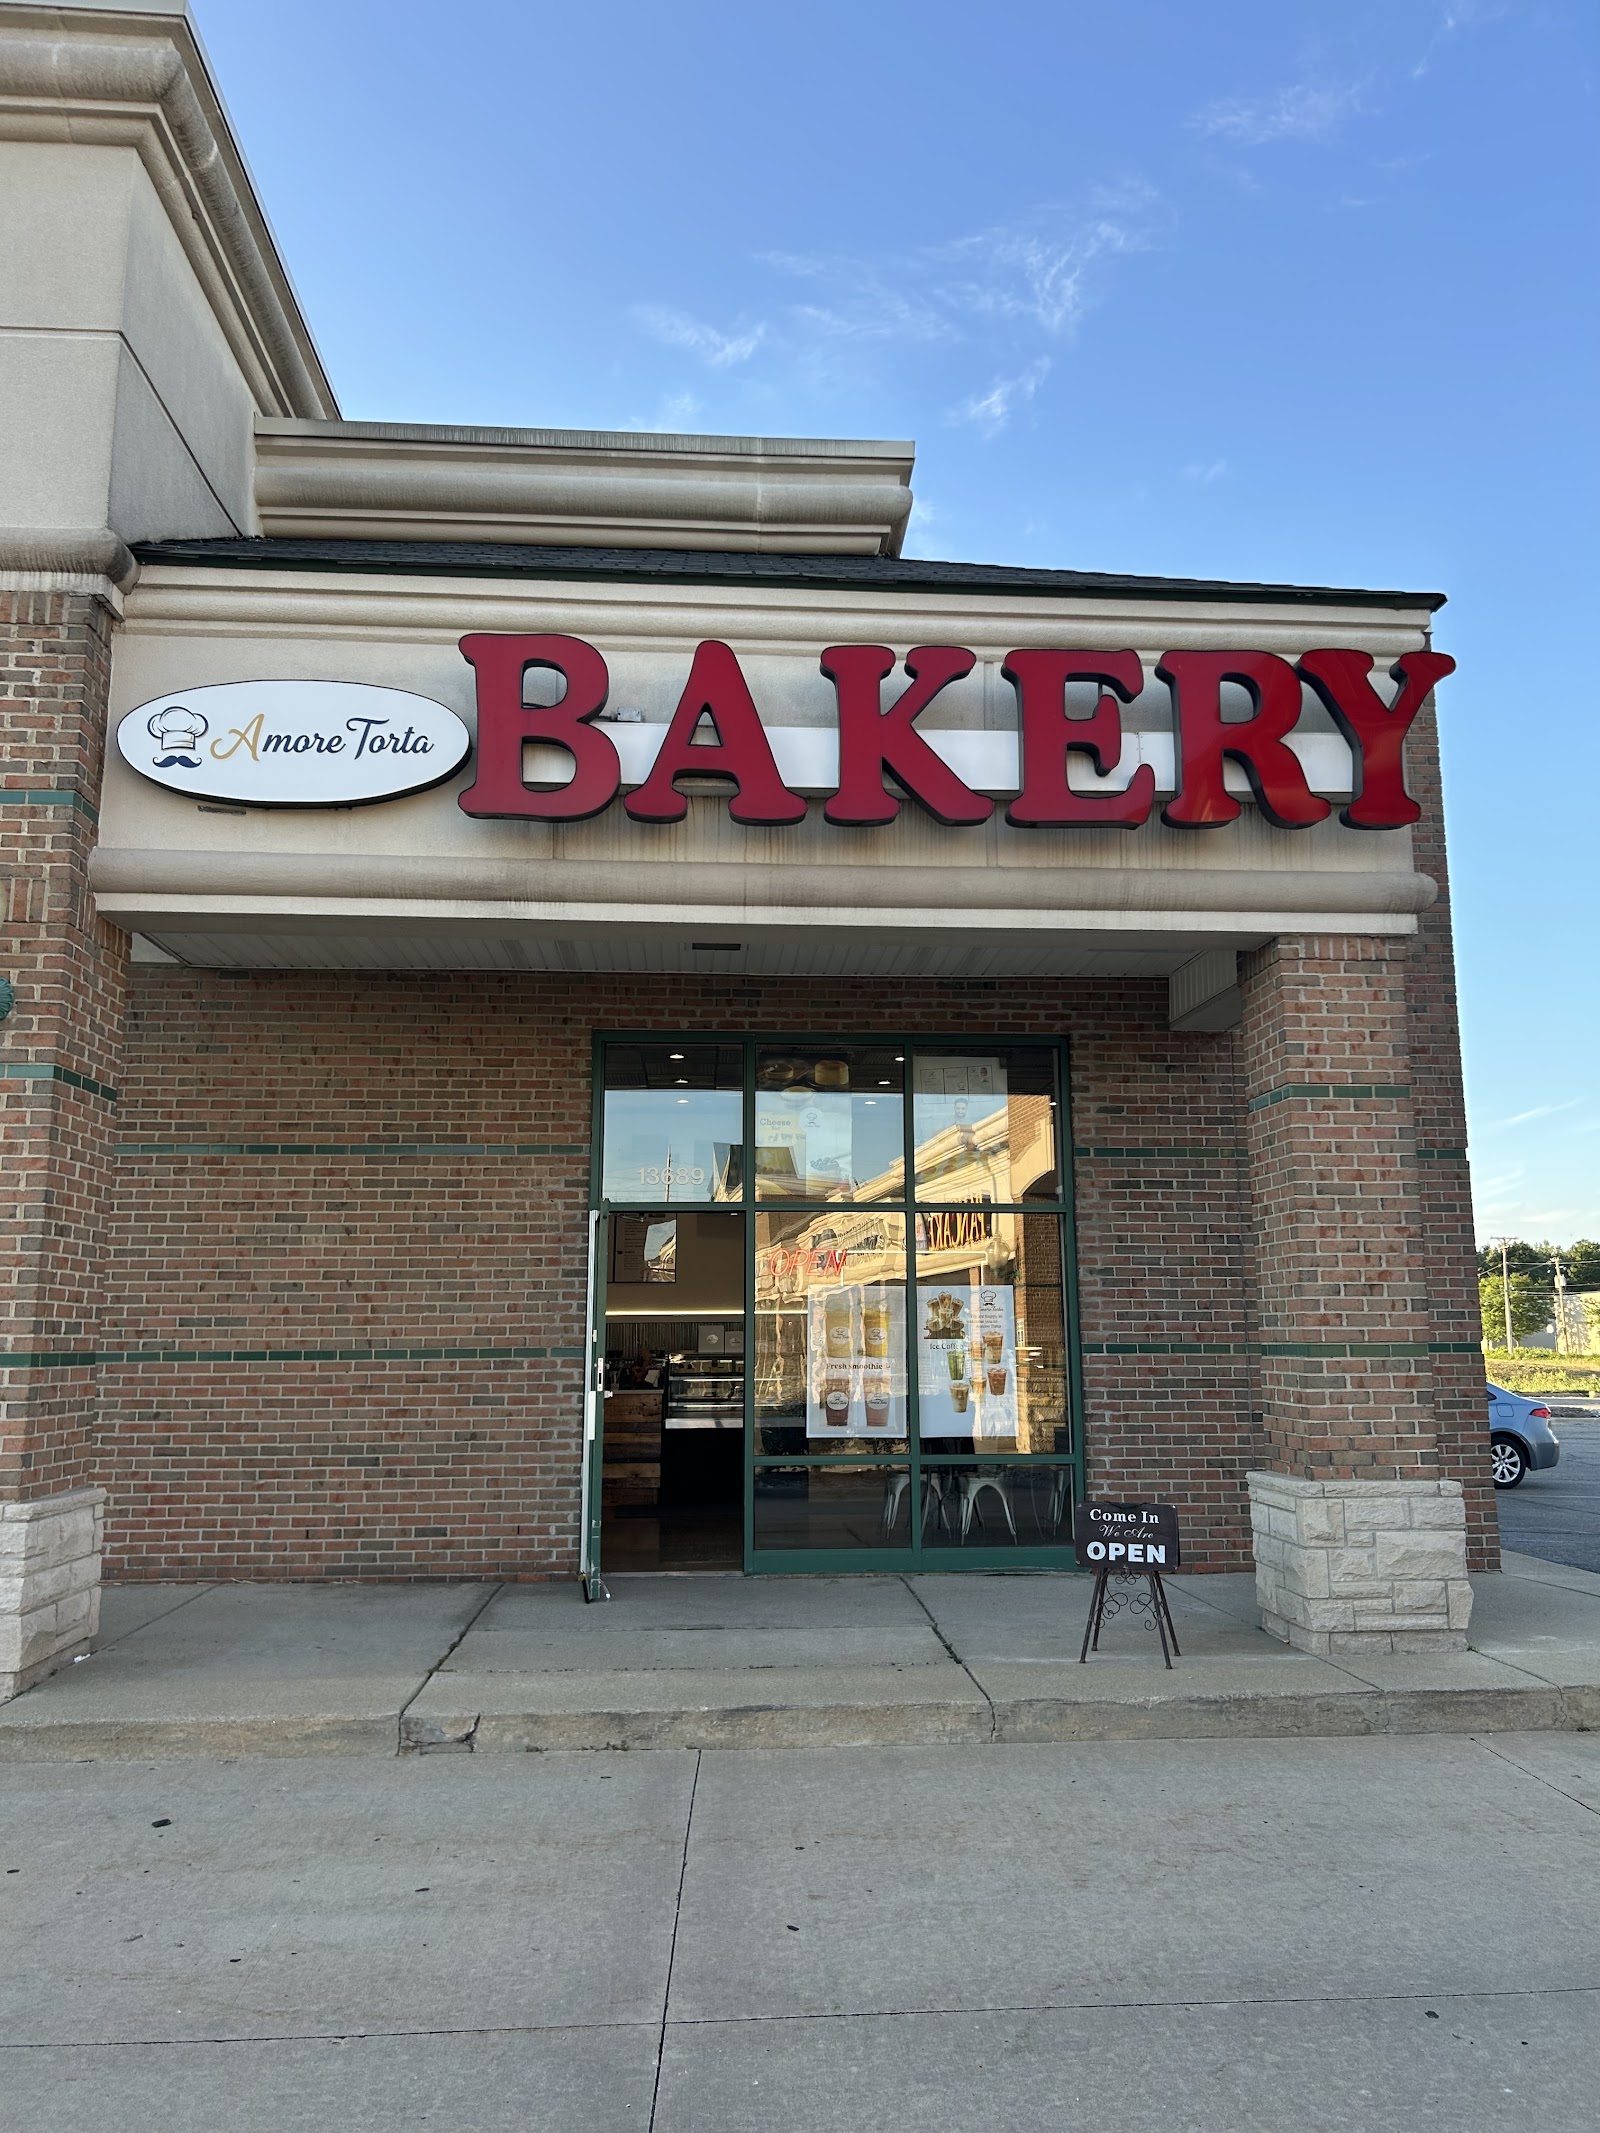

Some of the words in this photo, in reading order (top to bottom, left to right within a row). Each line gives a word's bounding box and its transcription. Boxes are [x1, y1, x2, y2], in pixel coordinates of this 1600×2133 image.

[210, 713, 346, 762] Amore
[346, 717, 434, 760] Torta
[458, 632, 1456, 829] BAKERY
[759, 1118, 791, 1126] Cheese
[636, 1167, 705, 1186] 13689
[769, 1248, 847, 1277] OPEN
[1089, 1508, 1137, 1523] Come
[1141, 1511, 1160, 1524] In
[1099, 1524, 1120, 1538] We
[1123, 1526, 1154, 1539] Are
[1086, 1541, 1166, 1564] OPEN
